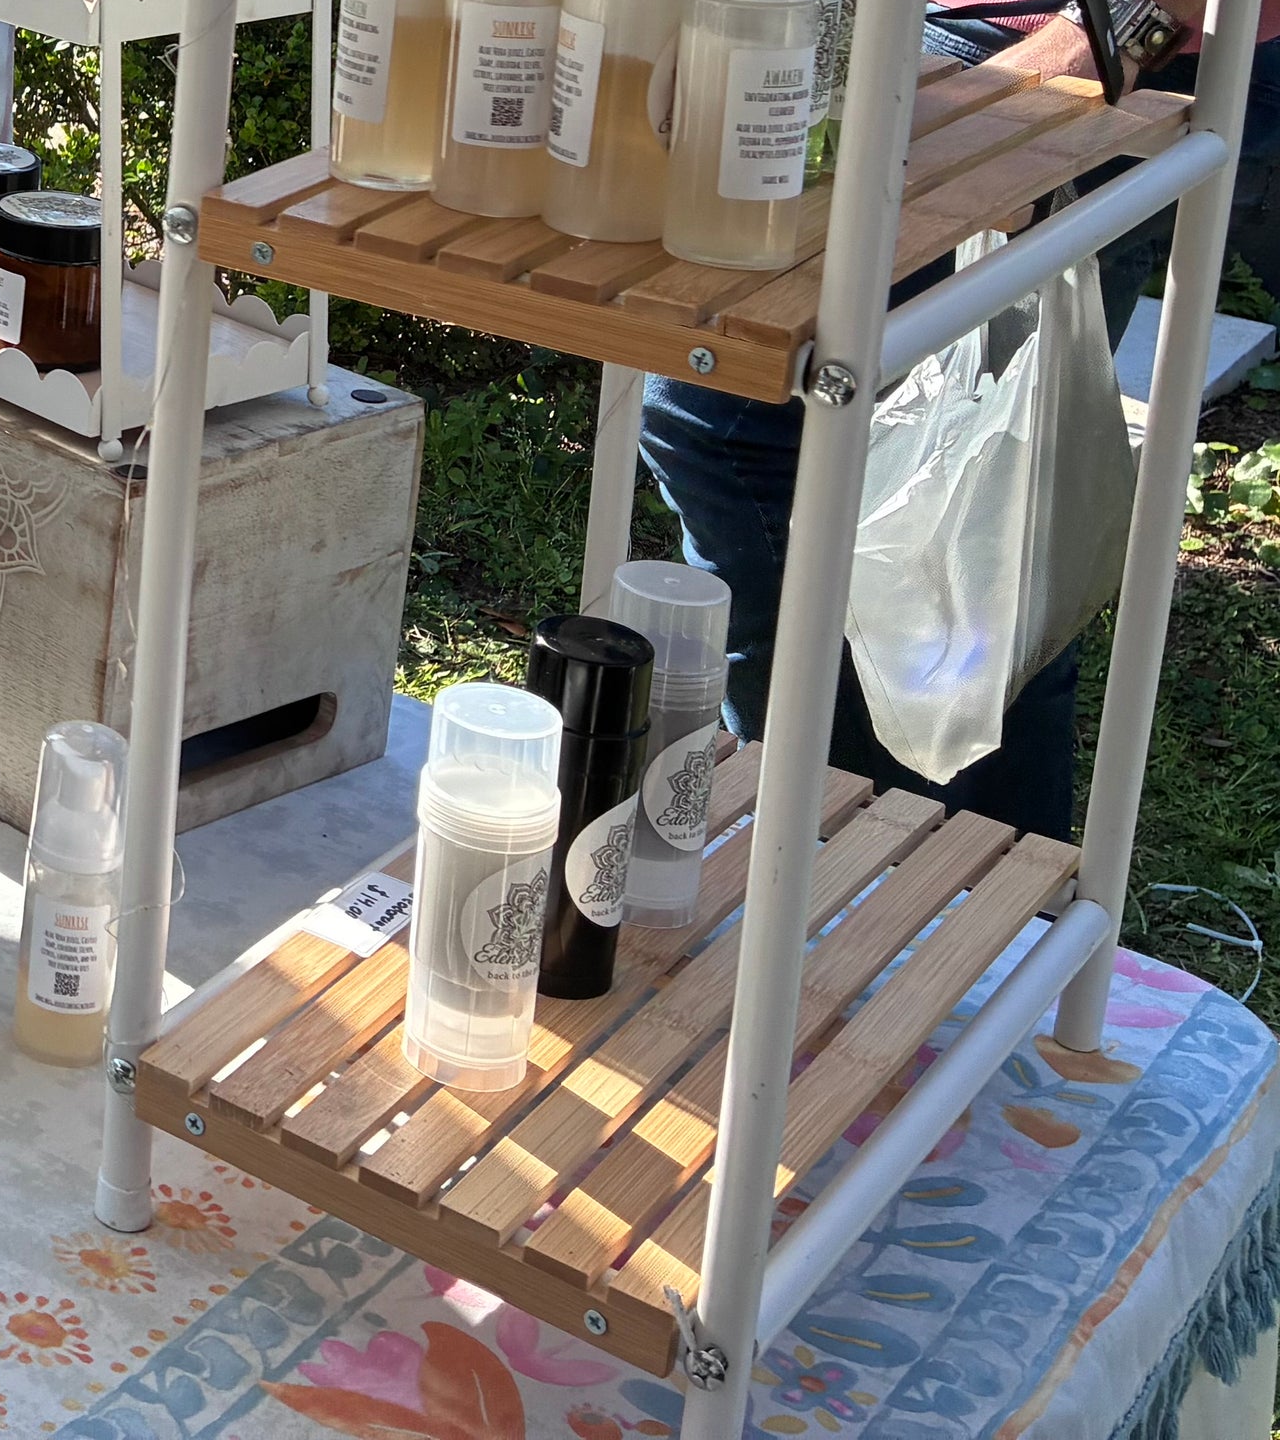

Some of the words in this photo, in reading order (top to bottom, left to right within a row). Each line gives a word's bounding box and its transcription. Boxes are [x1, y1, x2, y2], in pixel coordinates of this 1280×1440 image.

[763, 69, 804, 86] AWAKEN
[55, 913, 88, 930] SUNRISE
[487, 971, 509, 980] back
